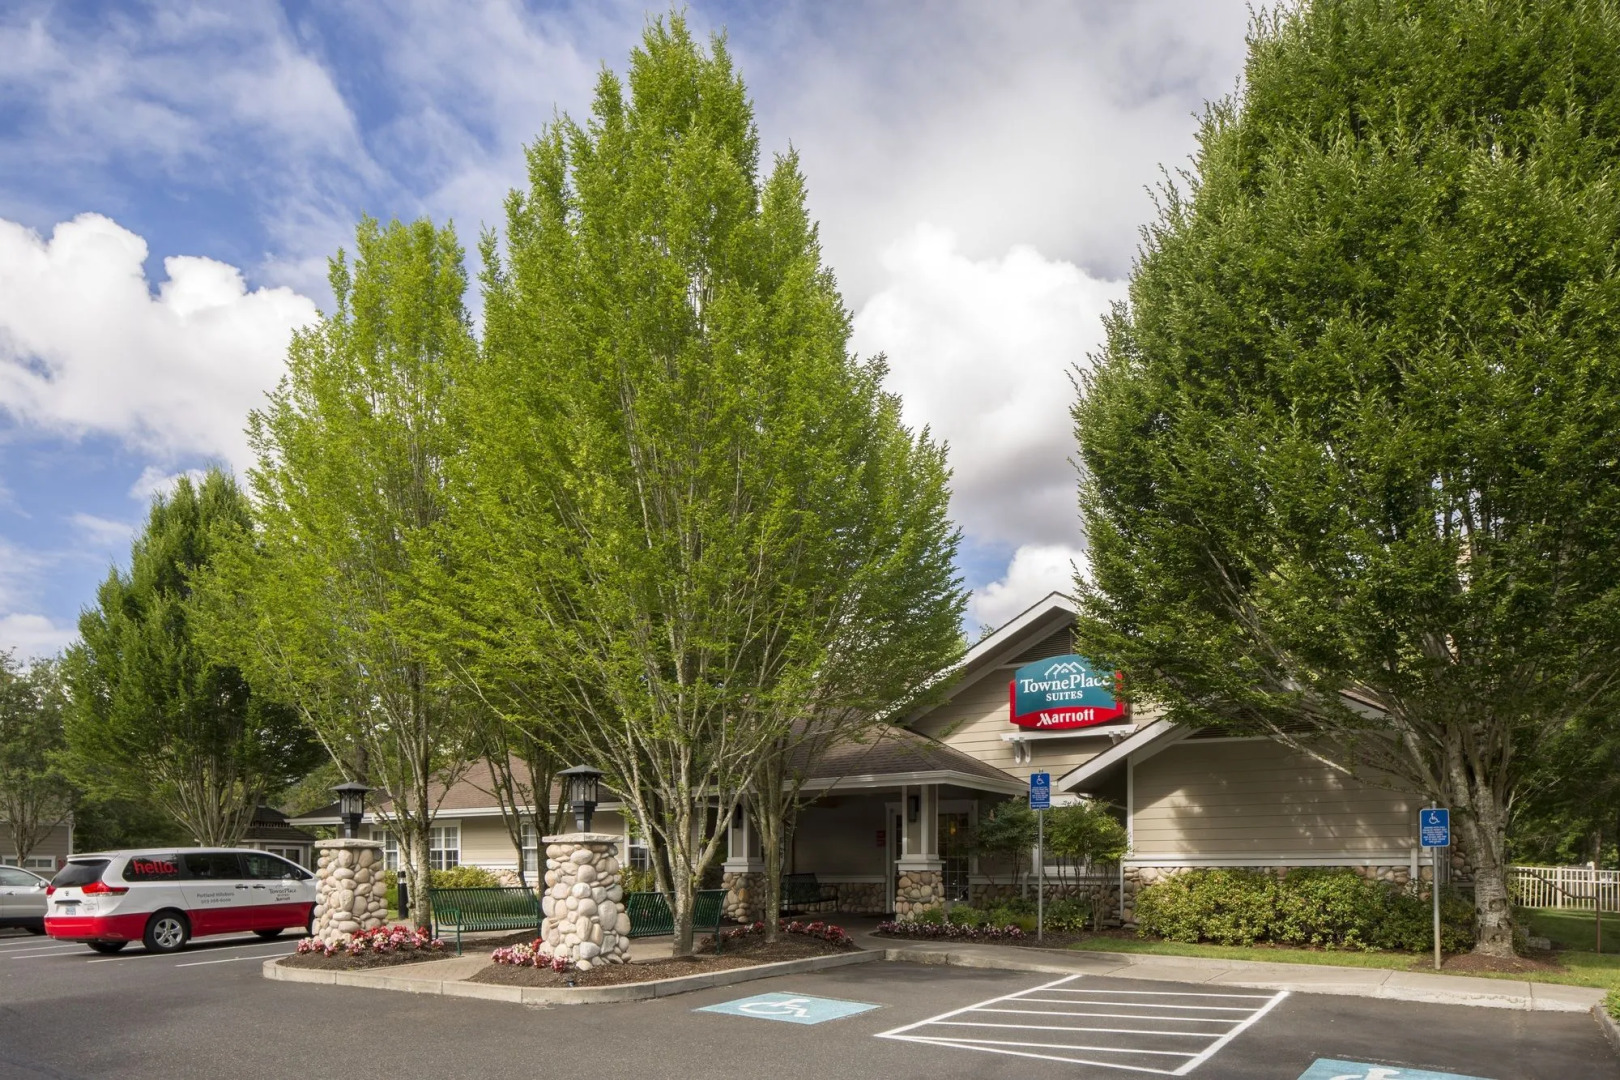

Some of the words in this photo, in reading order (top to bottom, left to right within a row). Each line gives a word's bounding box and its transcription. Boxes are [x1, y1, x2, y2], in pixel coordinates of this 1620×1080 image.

[1046, 690, 1083, 701] SUITES
[1036, 709, 1094, 727] Marriott
[133, 859, 178, 874] hello.
